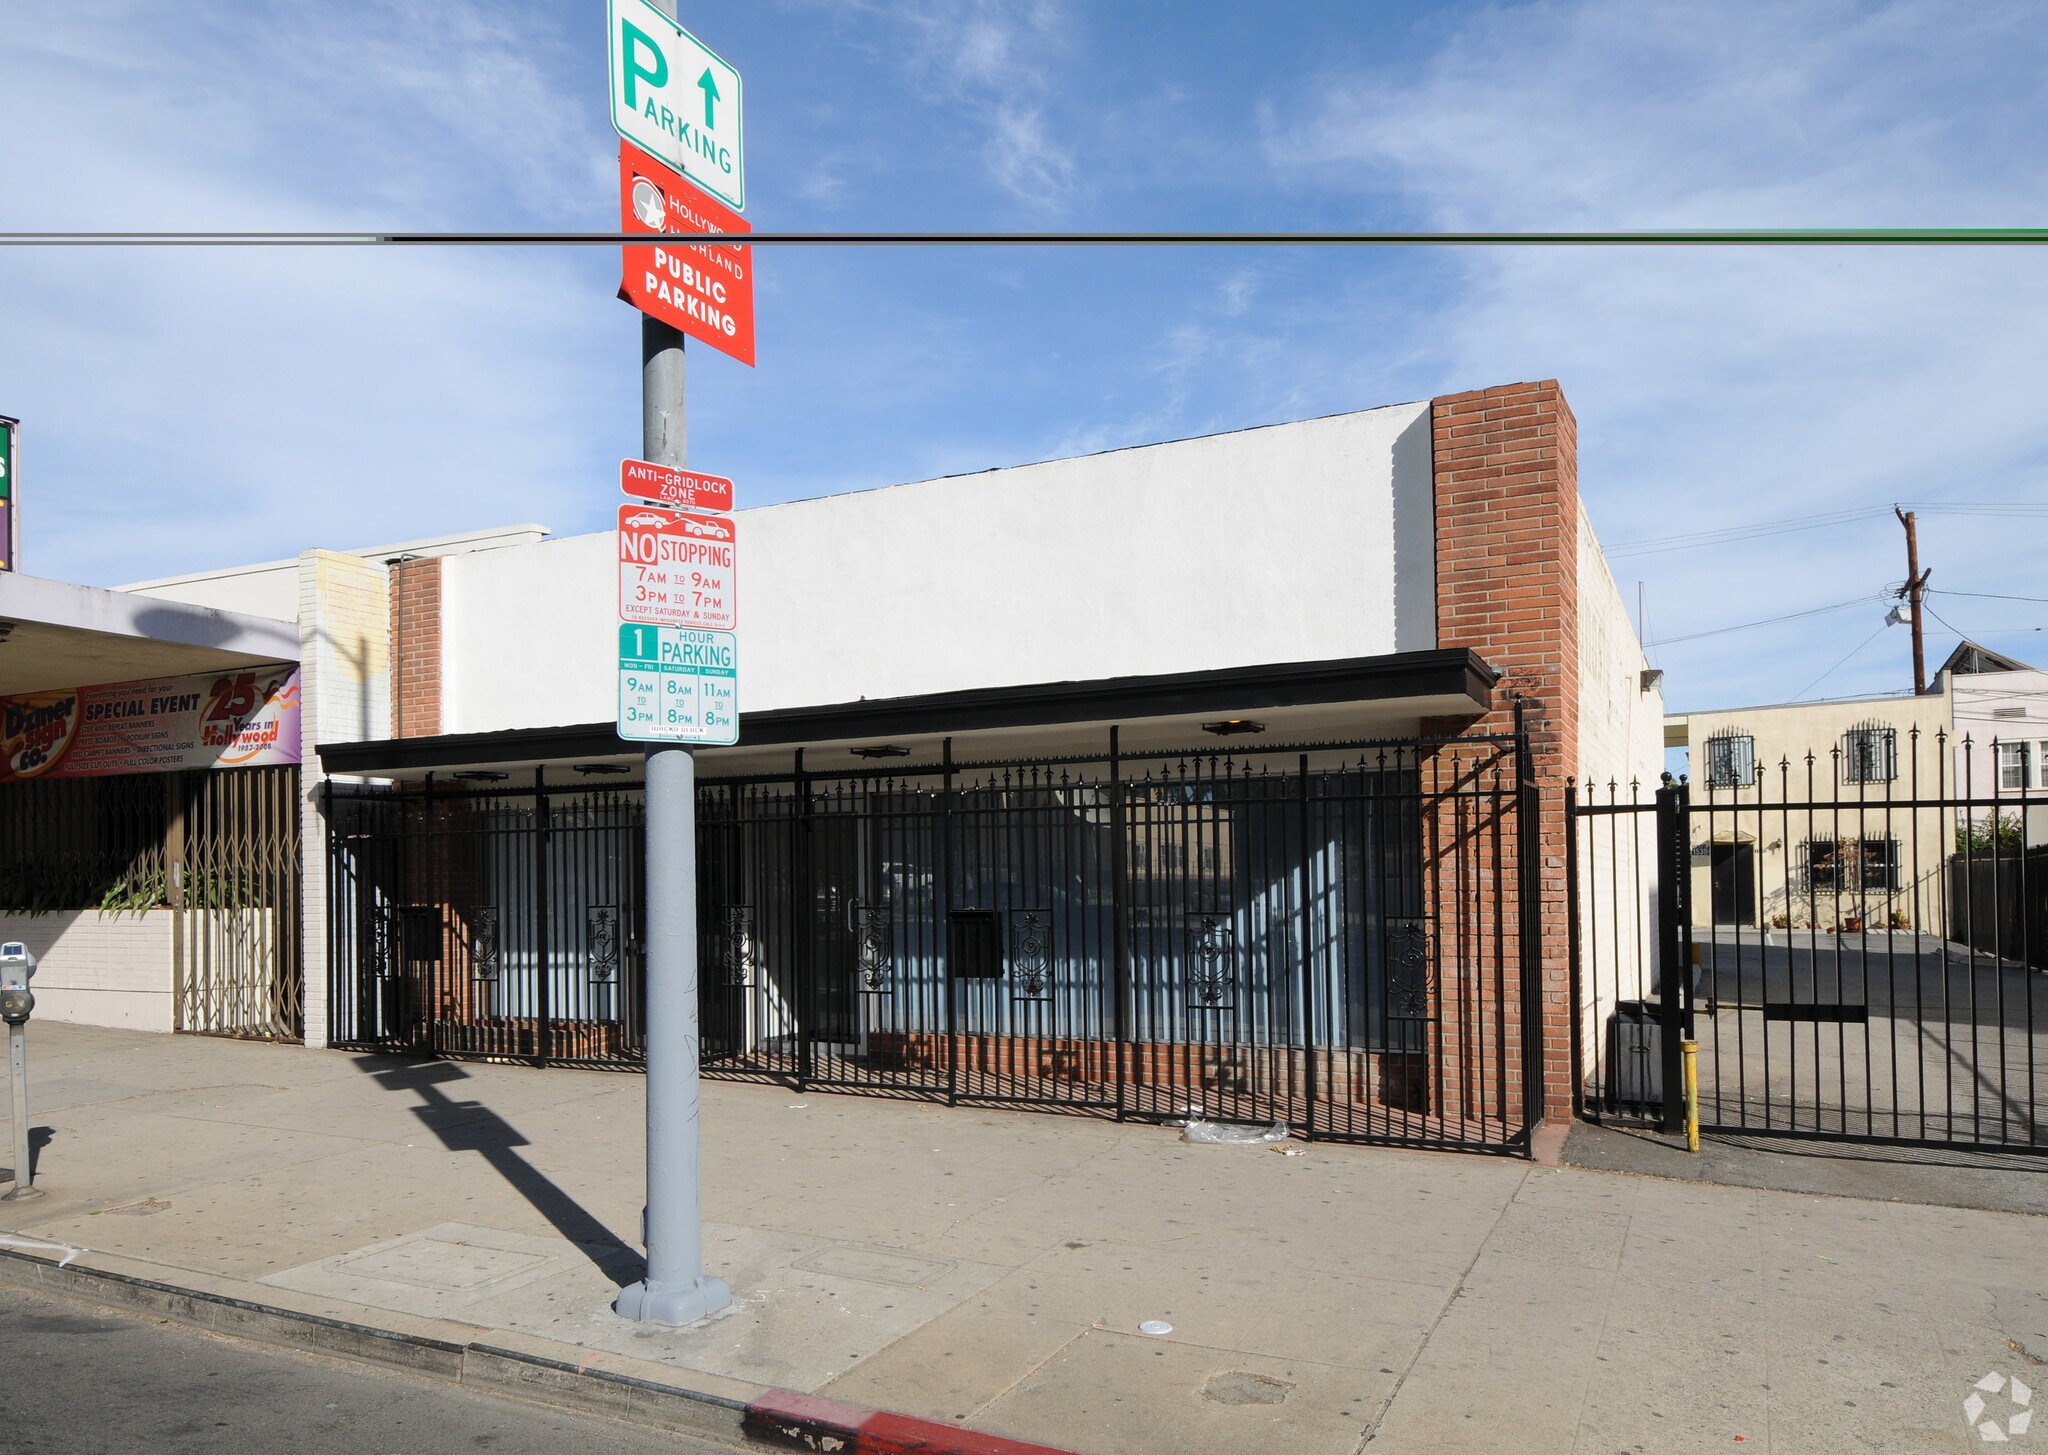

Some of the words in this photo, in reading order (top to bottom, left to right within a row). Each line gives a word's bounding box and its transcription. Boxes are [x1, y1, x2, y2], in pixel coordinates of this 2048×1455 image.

[622, 17, 731, 174] PARKING
[655, 247, 726, 303] PUBLIC
[645, 271, 736, 336] PARKING
[628, 466, 726, 495] ANTI-GRIDLOCK
[660, 484, 695, 501] ZONE
[621, 531, 657, 562] NO
[661, 540, 731, 568] STOPPING
[635, 566, 667, 584] 7AM
[674, 575, 685, 583] TO
[691, 572, 721, 590] 9AM
[635, 585, 667, 603] 3PM
[674, 594, 685, 602] TO
[692, 591, 722, 609] 7PM
[625, 604, 652, 614] EXCEPT
[654, 607, 691, 617] SATURDAY
[693, 611, 699, 619] &
[703, 611, 730, 621] SUNDAY
[634, 628, 643, 657] 1
[679, 631, 714, 644] HOUR
[662, 642, 731, 667] PARKING
[663, 665, 695, 673] SATURDAY
[705, 668, 729, 676] SUNDAY
[86, 690, 116, 699] Everything
[131, 687, 146, 695] need
[148, 685, 158, 693] for
[158, 685, 173, 694] your
[627, 677, 653, 692] 9AM
[667, 680, 692, 695] 8AM
[704, 683, 731, 697] 11AM
[207, 672, 256, 721] 25
[637, 696, 646, 704] TO
[85, 700, 145, 721] SPECIAL
[150, 693, 201, 715] EVENT
[715, 701, 723, 709] TO
[627, 707, 653, 721] 3PM
[667, 709, 692, 724] 8PM
[705, 711, 729, 726] 8PM
[94, 724, 107, 732] AND
[108, 722, 128, 731] REPEAT
[128, 720, 155, 729] BANNERS
[233, 717, 261, 732] Years
[264, 721, 274, 729] in
[25, 718, 67, 752] sign
[79, 737, 94, 745] PRESS
[94, 736, 118, 744] BOARDS
[126, 733, 150, 742] PODIUM
[151, 731, 169, 739] SIGNS
[202, 720, 279, 748] Hollywood
[72, 750, 83, 758] RED
[84, 749, 105, 757] CARPET
[105, 747, 131, 756] BANNERS
[137, 743, 174, 753] DIRECTIONAL
[175, 742, 194, 750] SIGNS
[20, 747, 47, 771] co.
[64, 762, 77, 771] FULL
[91, 761, 103, 769] CUT
[103, 760, 118, 768] OUTS
[139, 757, 159, 765] COLOR
[159, 755, 184, 764] POSTERS
